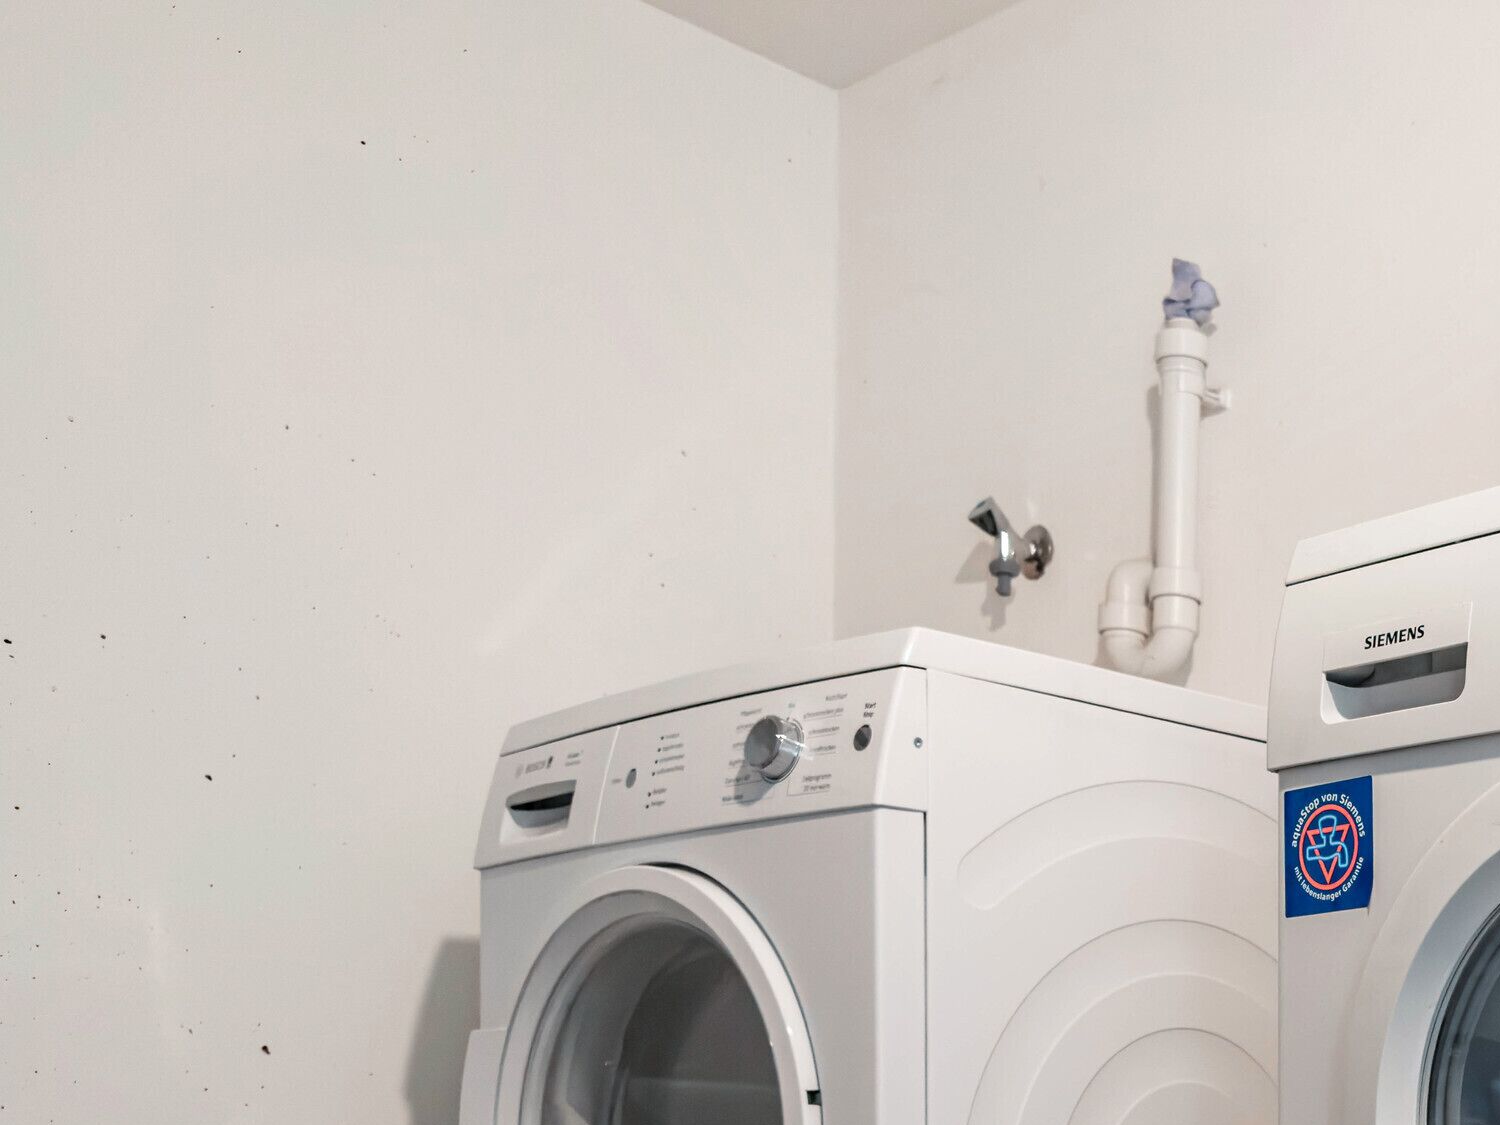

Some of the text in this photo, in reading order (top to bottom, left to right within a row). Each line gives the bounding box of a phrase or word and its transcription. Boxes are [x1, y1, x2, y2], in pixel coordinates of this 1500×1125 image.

[1364, 625, 1425, 650] SIEMENS
[1291, 793, 1366, 848] aquaStop von Siemens
[1294, 856, 1364, 901] mit lebenslanger Garantie
